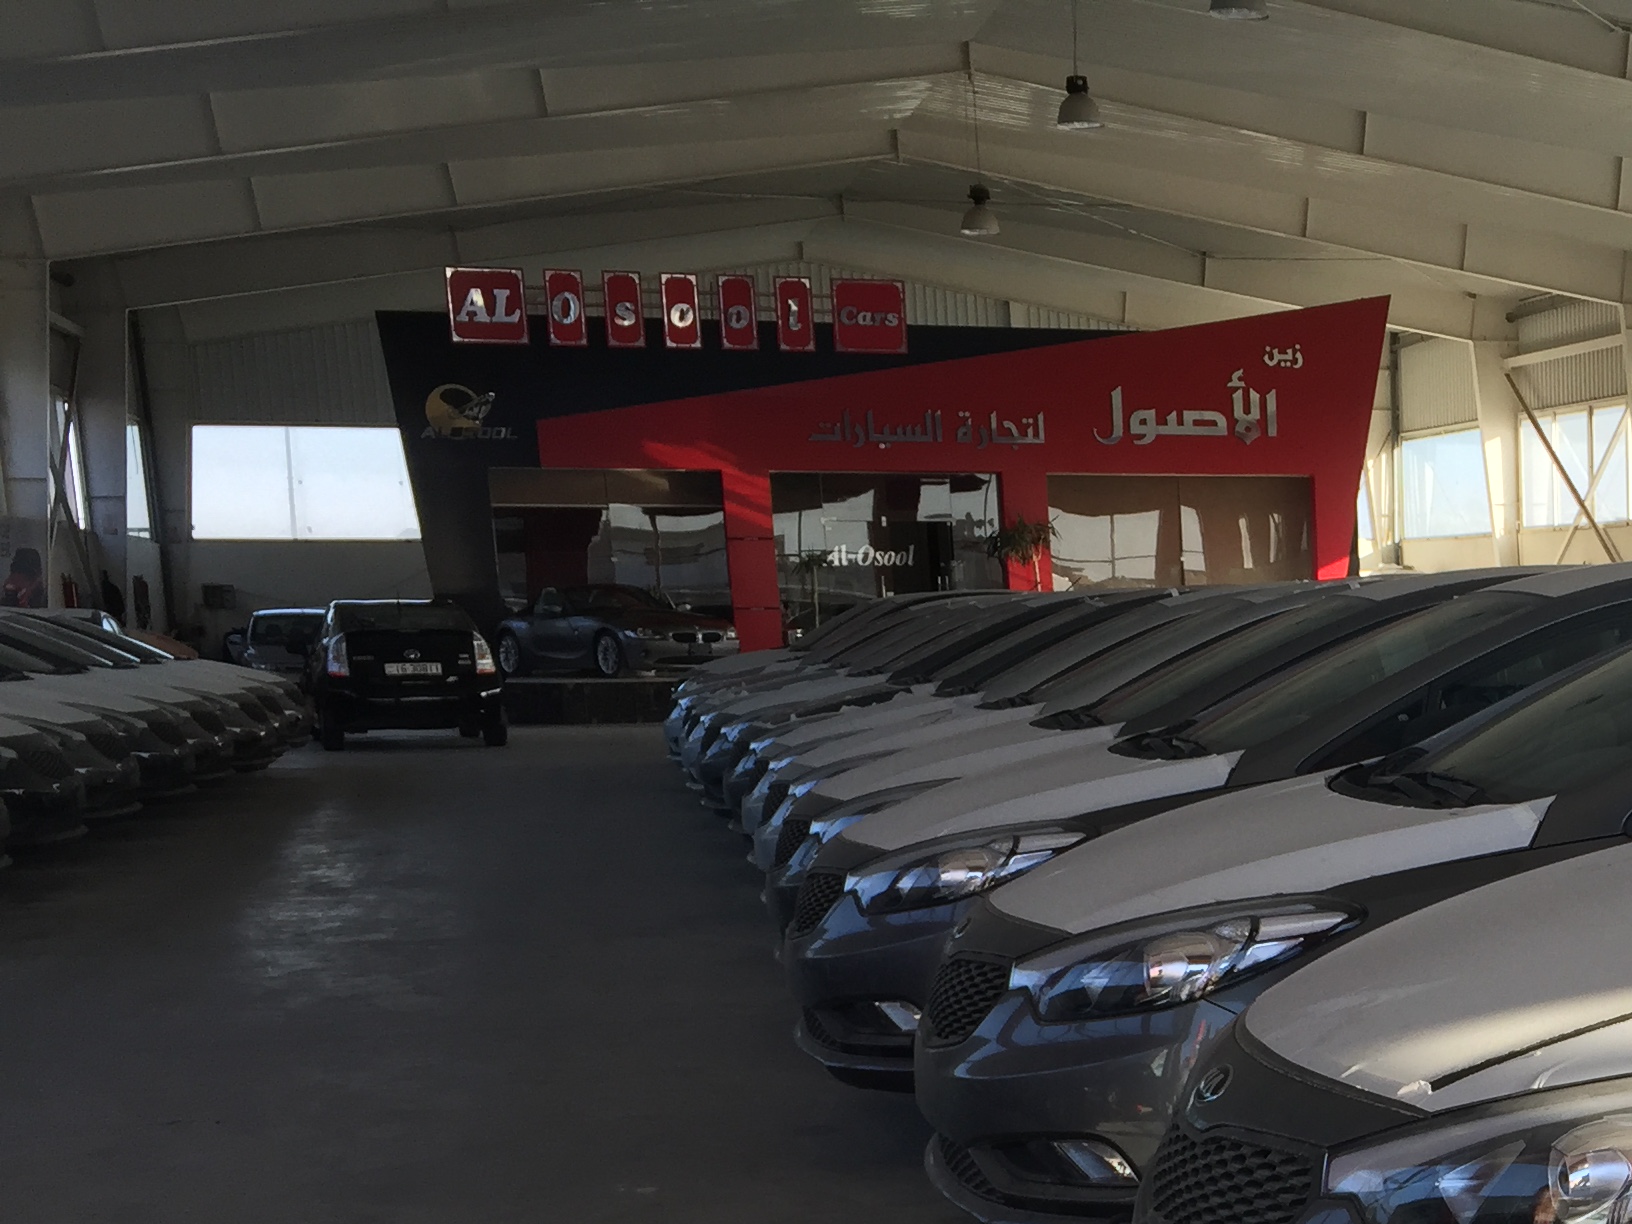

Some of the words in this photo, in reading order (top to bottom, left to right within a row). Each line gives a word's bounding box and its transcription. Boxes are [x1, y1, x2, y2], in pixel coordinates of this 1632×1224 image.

[456, 288, 521, 323] AL
[840, 306, 899, 326] Cars
[1263, 344, 1303, 368] زين
[1093, 368, 1277, 445] الأصول
[808, 408, 942, 449] السيارات
[957, 410, 1045, 449] لتجارة
[822, 544, 915, 566] Al-Osool
